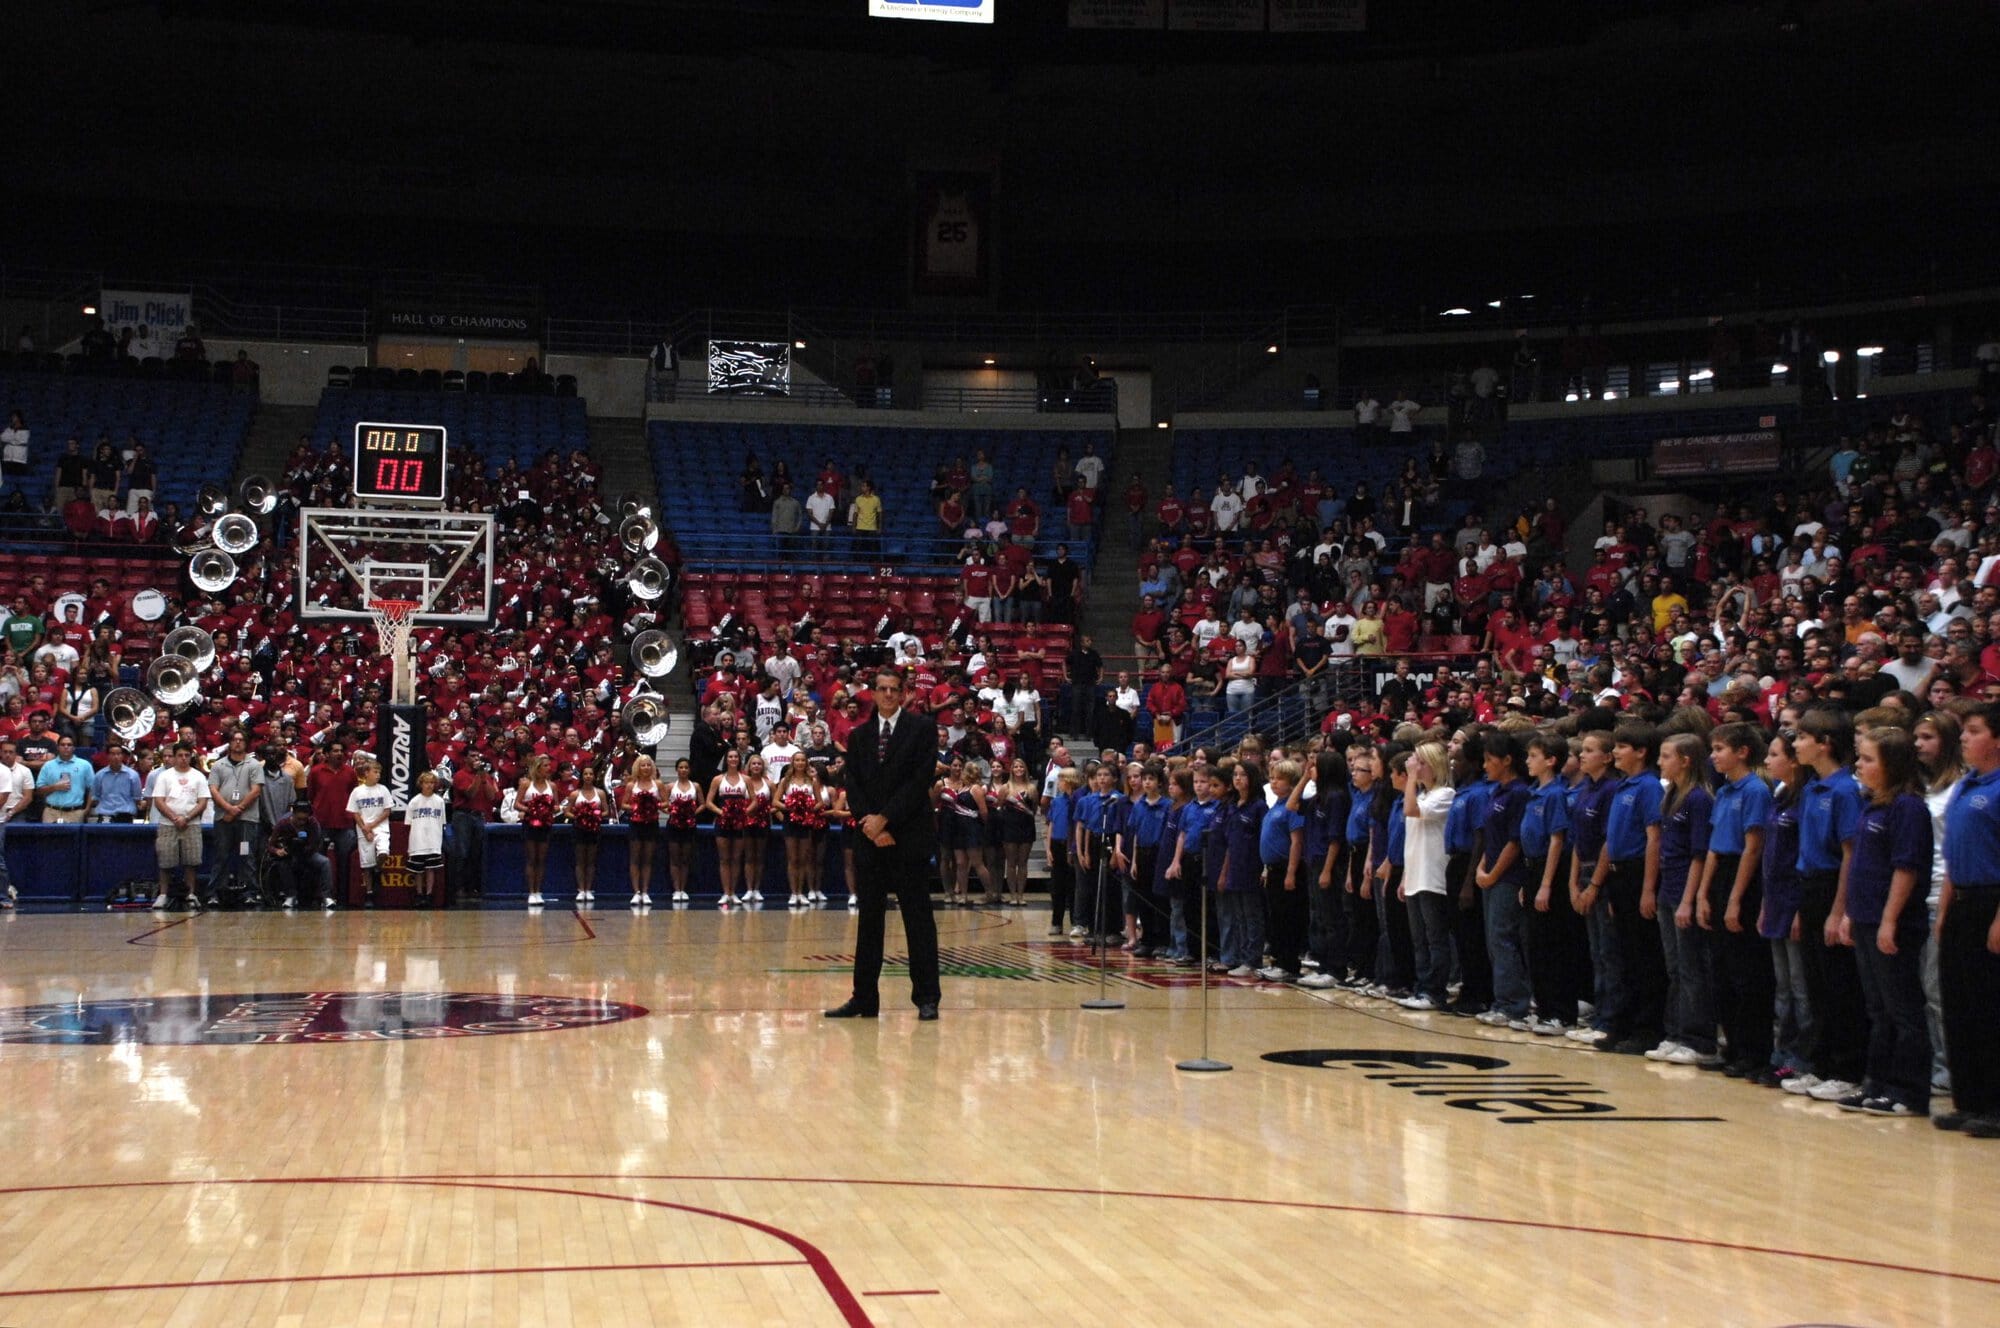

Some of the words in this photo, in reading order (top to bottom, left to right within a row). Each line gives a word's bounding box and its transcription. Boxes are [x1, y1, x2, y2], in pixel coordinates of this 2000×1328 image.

[108, 300, 139, 324] Jim
[145, 302, 185, 326] Click
[391, 312, 424, 325] HALL
[430, 314, 447, 325] OF
[450, 315, 528, 329] CHAMPIONS
[376, 458, 423, 491] 00
[880, 567, 893, 577] 22
[765, 717, 774, 726] 31
[391, 712, 411, 812] ARIZONA
